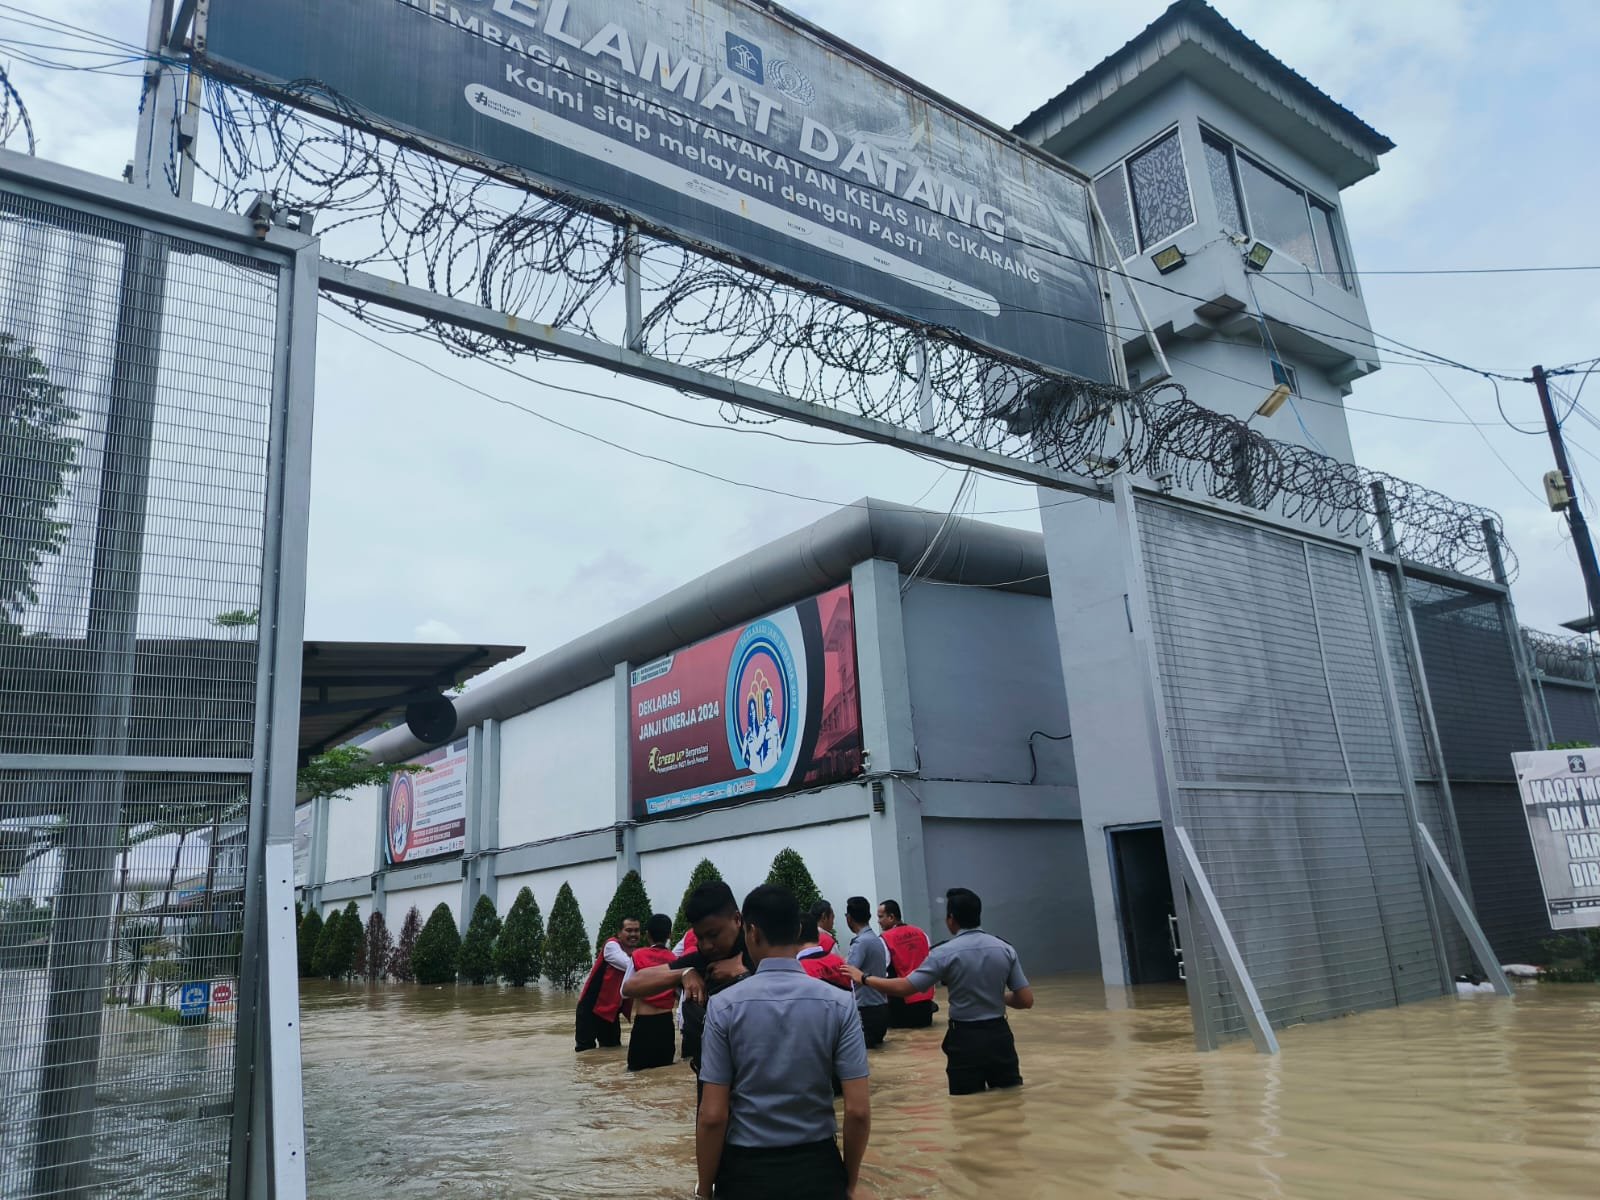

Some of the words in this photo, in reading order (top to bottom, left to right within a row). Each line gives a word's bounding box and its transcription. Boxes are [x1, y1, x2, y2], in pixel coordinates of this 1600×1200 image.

[473, 0, 783, 135] ELAMAT
[799, 116, 1005, 243] DATANG
[505, 64, 583, 112] Kami
[592, 104, 651, 142] siap
[659, 132, 774, 193] melayani
[781, 185, 862, 230] dengan
[869, 220, 923, 256] PASTI
[585, 66, 837, 195] PEMASYARAKATAN
[844, 183, 908, 226] KELAS
[915, 216, 941, 241] IIA
[946, 231, 1041, 284] CIKARANG
[638, 688, 680, 717] DEKLARASI
[638, 719, 661, 741] JANJI
[662, 708, 697, 734] KINERJA
[698, 700, 719, 722] 2024
[1529, 778, 1580, 804] KACA
[1547, 805, 1585, 832] DAN
